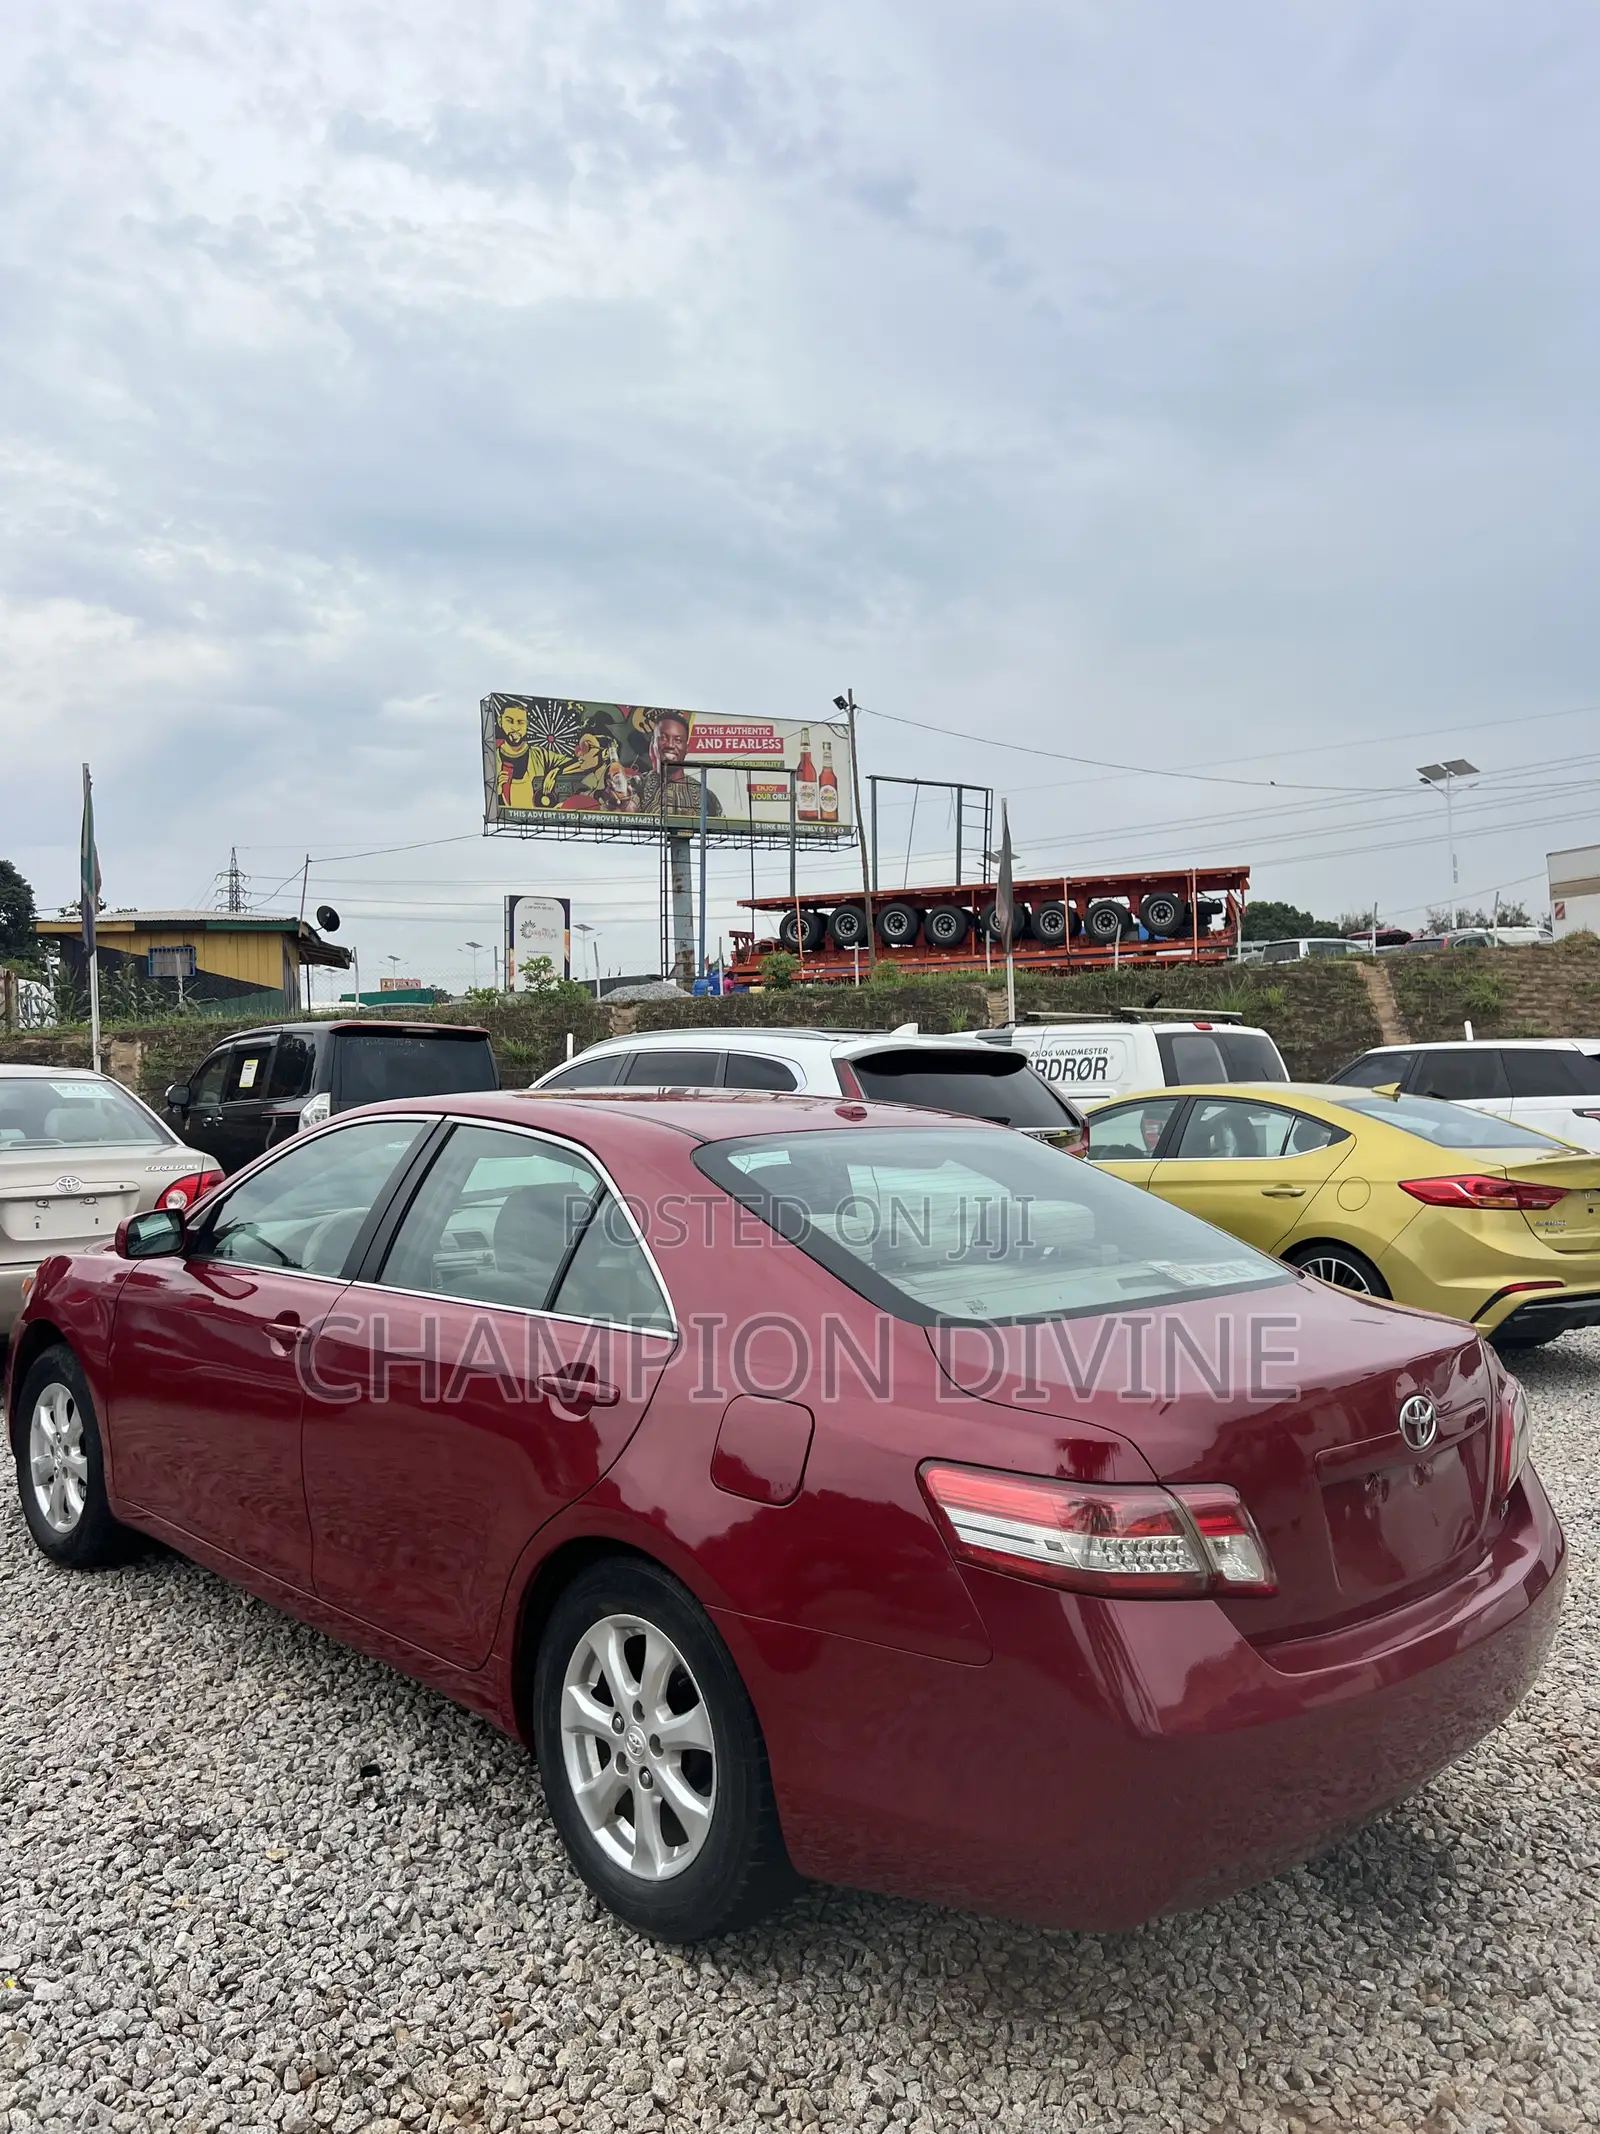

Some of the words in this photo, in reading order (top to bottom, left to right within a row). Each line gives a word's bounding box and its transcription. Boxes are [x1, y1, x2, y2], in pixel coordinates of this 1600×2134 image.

[695, 726, 707, 735] TO
[708, 727, 724, 735] THE
[725, 727, 771, 736] AUTHENTIC
[696, 738, 723, 749] AND
[725, 738, 782, 749] FEARLESS
[772, 793, 790, 801] ORIJI
[508, 810, 526, 818] THIS
[527, 811, 557, 819] ADVERT
[777, 824, 818, 832] RESNSIBLY
[1041, 1049, 1053, 1057] OG
[1055, 1047, 1108, 1057] VANDMESTER
